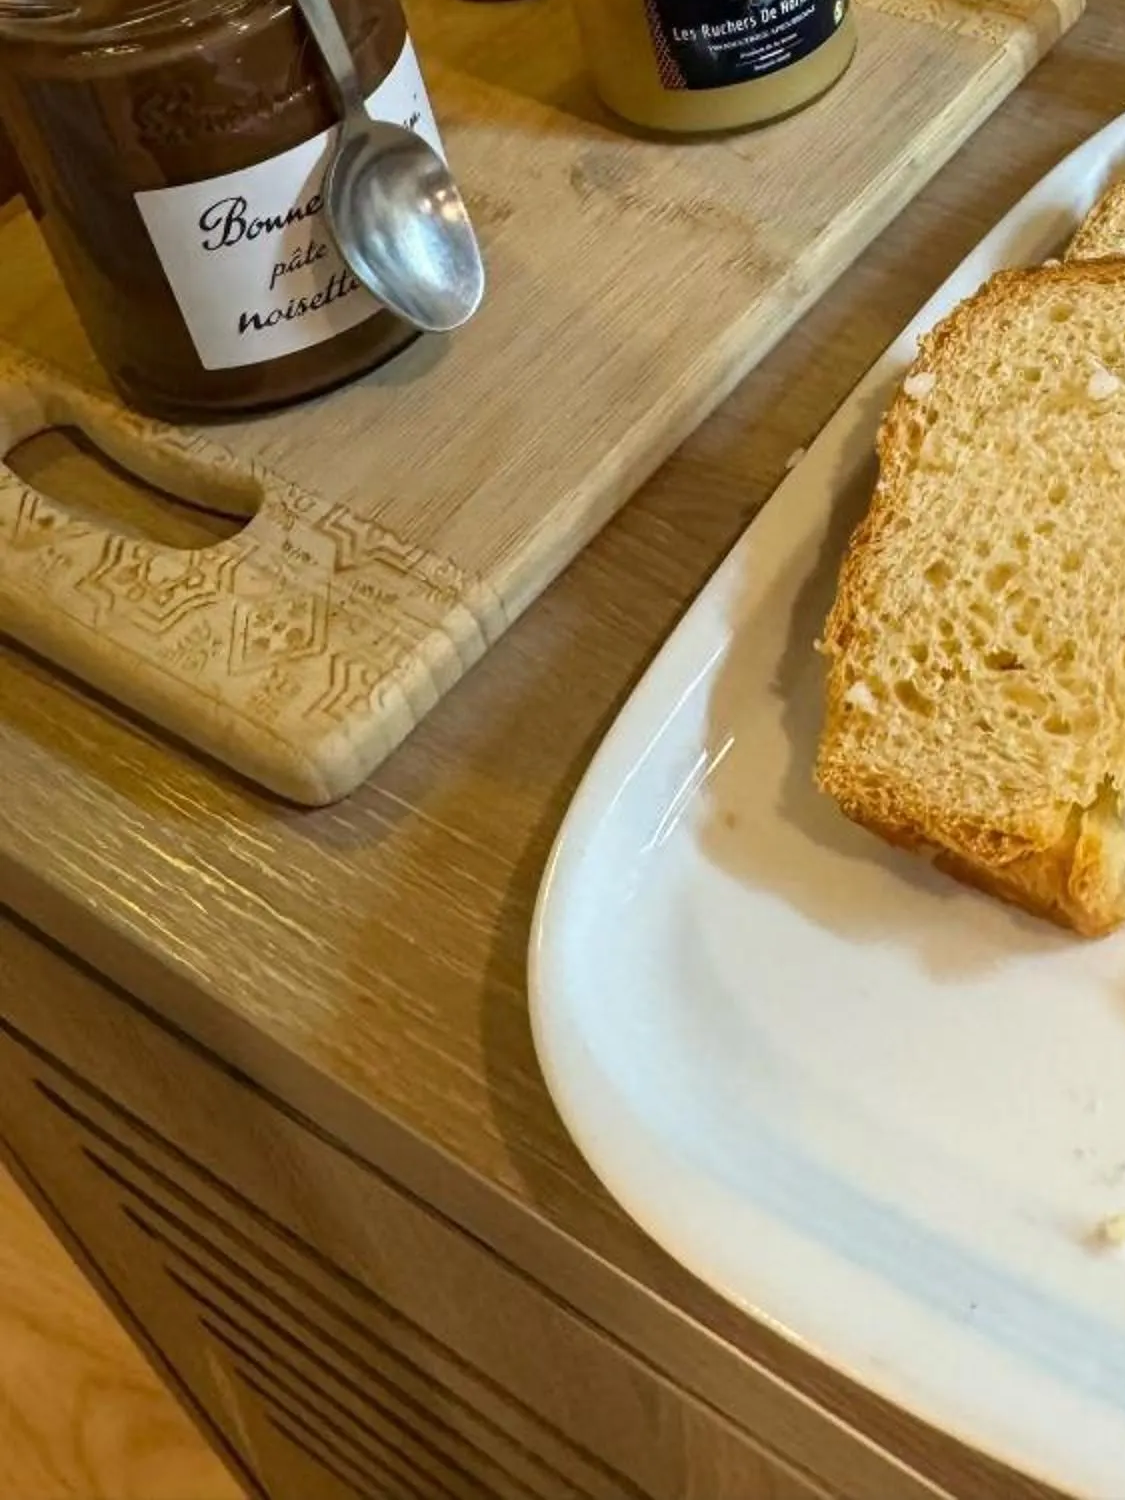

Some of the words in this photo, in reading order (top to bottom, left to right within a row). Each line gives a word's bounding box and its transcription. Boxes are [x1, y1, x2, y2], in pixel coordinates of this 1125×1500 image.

[672, 27, 697, 42] Les
[701, 15, 757, 39] Ruchers
[761, 9, 778, 23] De
[199, 195, 325, 251] Bonne
[269, 240, 327, 291] pâte
